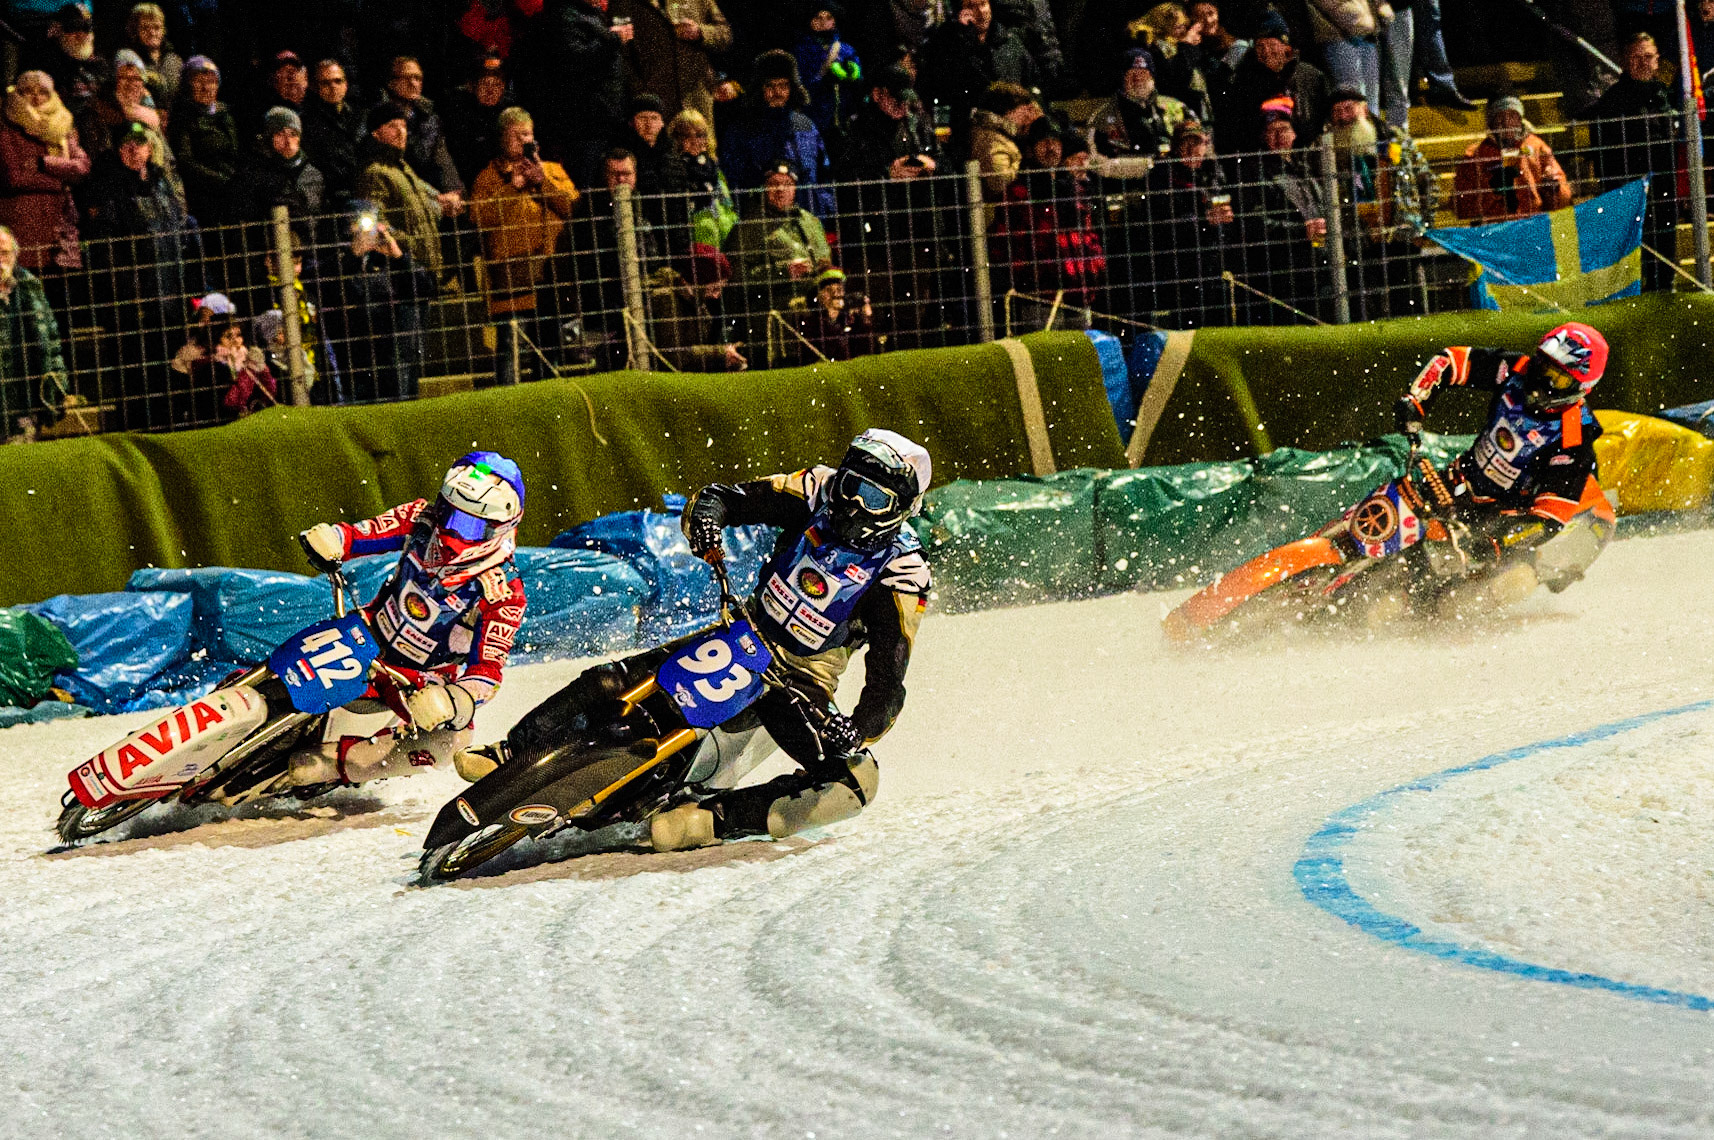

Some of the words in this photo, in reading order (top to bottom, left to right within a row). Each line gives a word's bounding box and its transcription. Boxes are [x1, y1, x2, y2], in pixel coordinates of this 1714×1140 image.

[300, 628, 362, 690] 412
[677, 639, 752, 703] 93
[117, 702, 225, 781] AVIA
